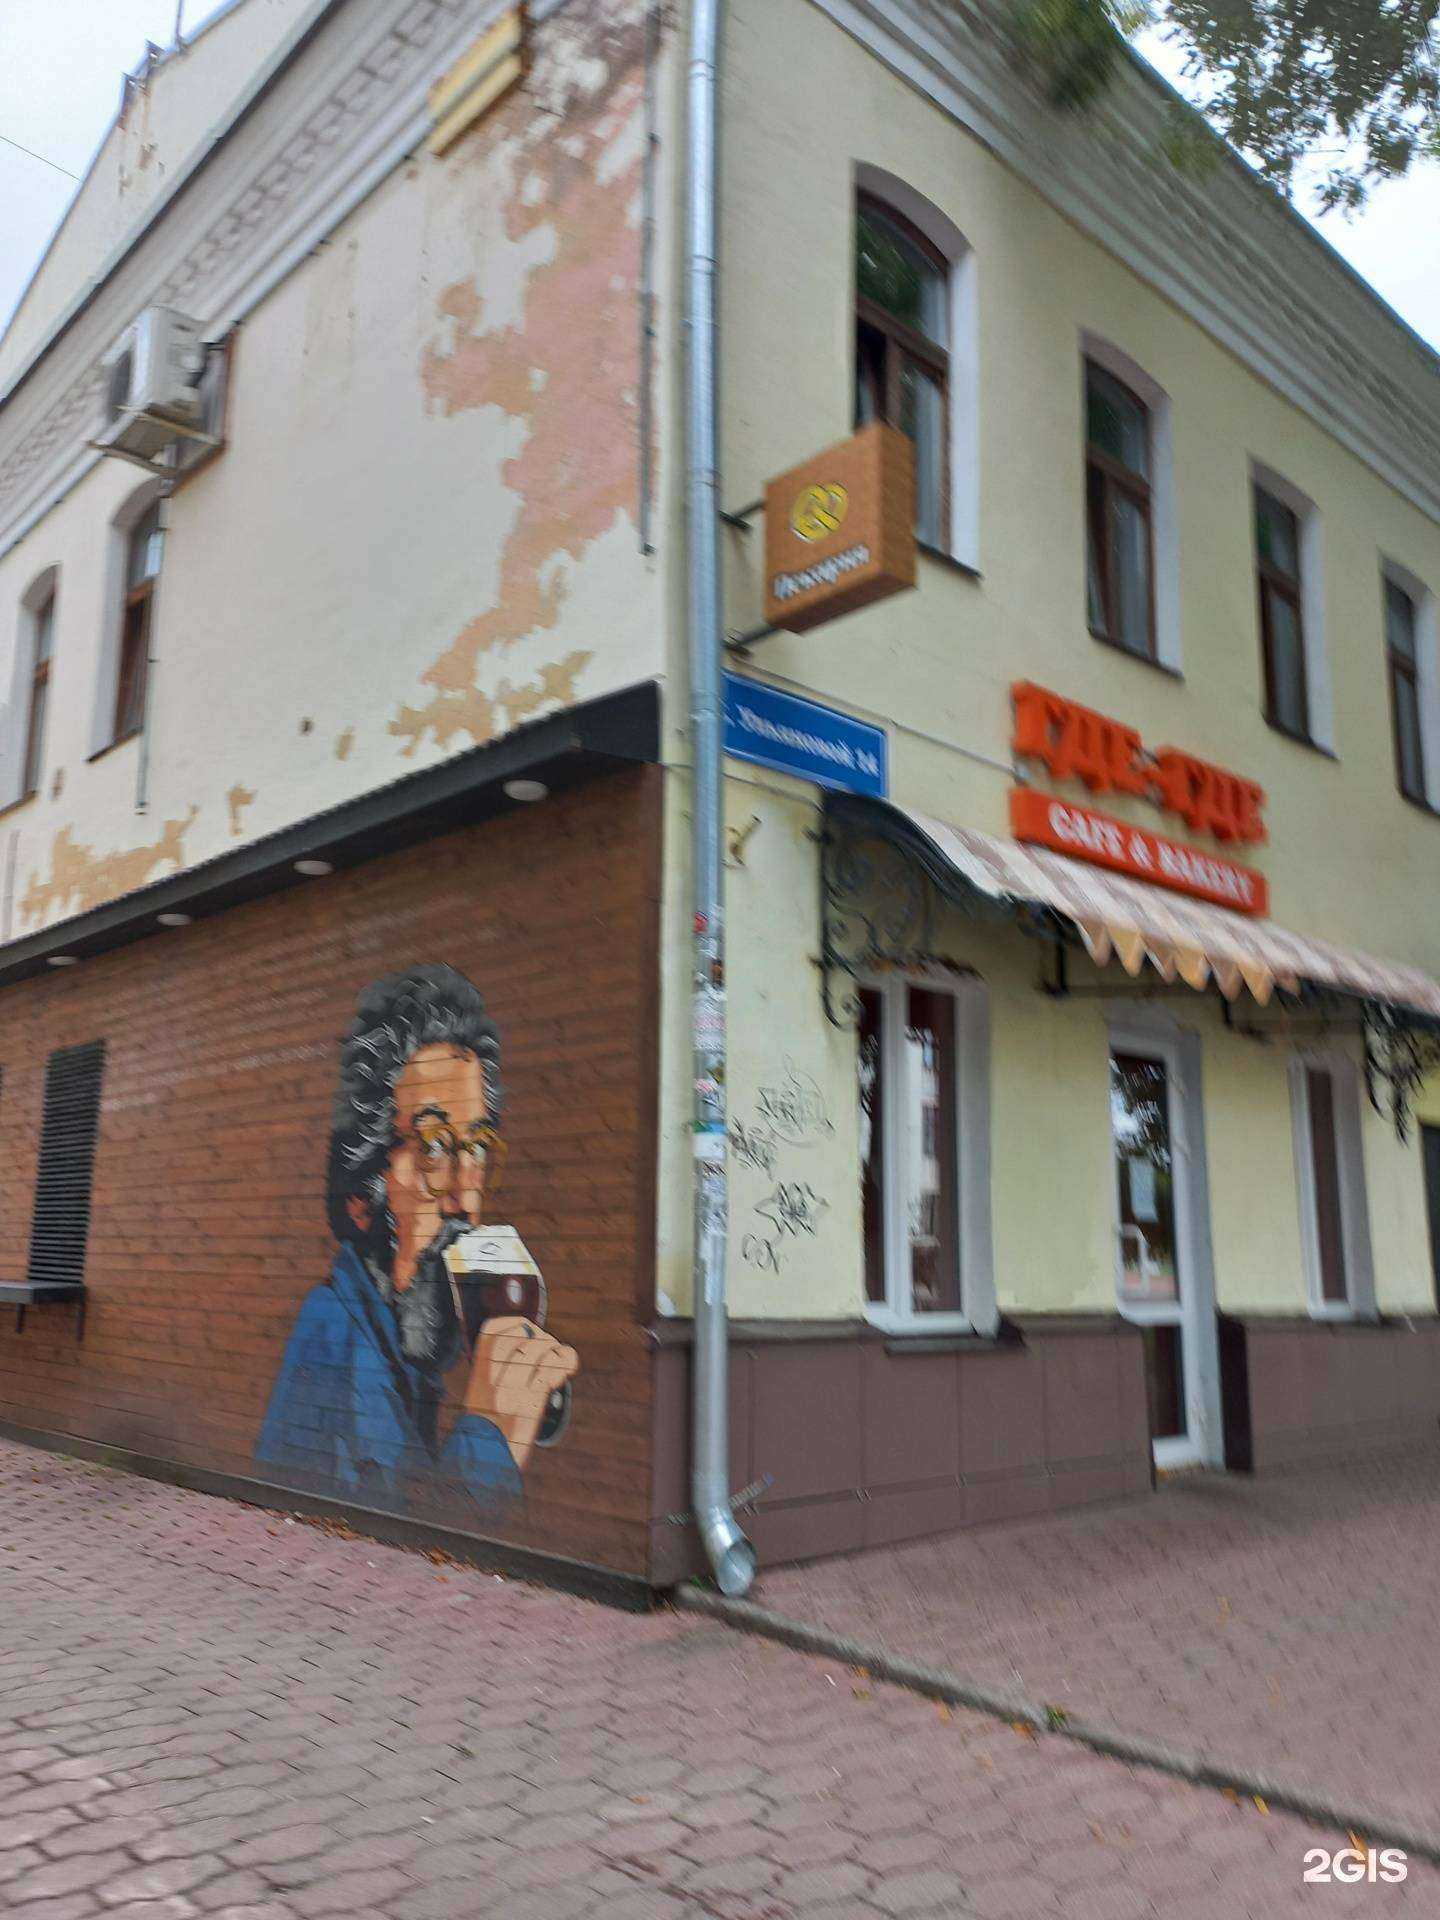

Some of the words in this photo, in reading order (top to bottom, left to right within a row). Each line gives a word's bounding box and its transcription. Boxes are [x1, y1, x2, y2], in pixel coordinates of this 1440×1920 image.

[1049, 801, 1127, 863] CAFE
[1128, 830, 1155, 872] &
[1156, 839, 1255, 907] BAKERY
